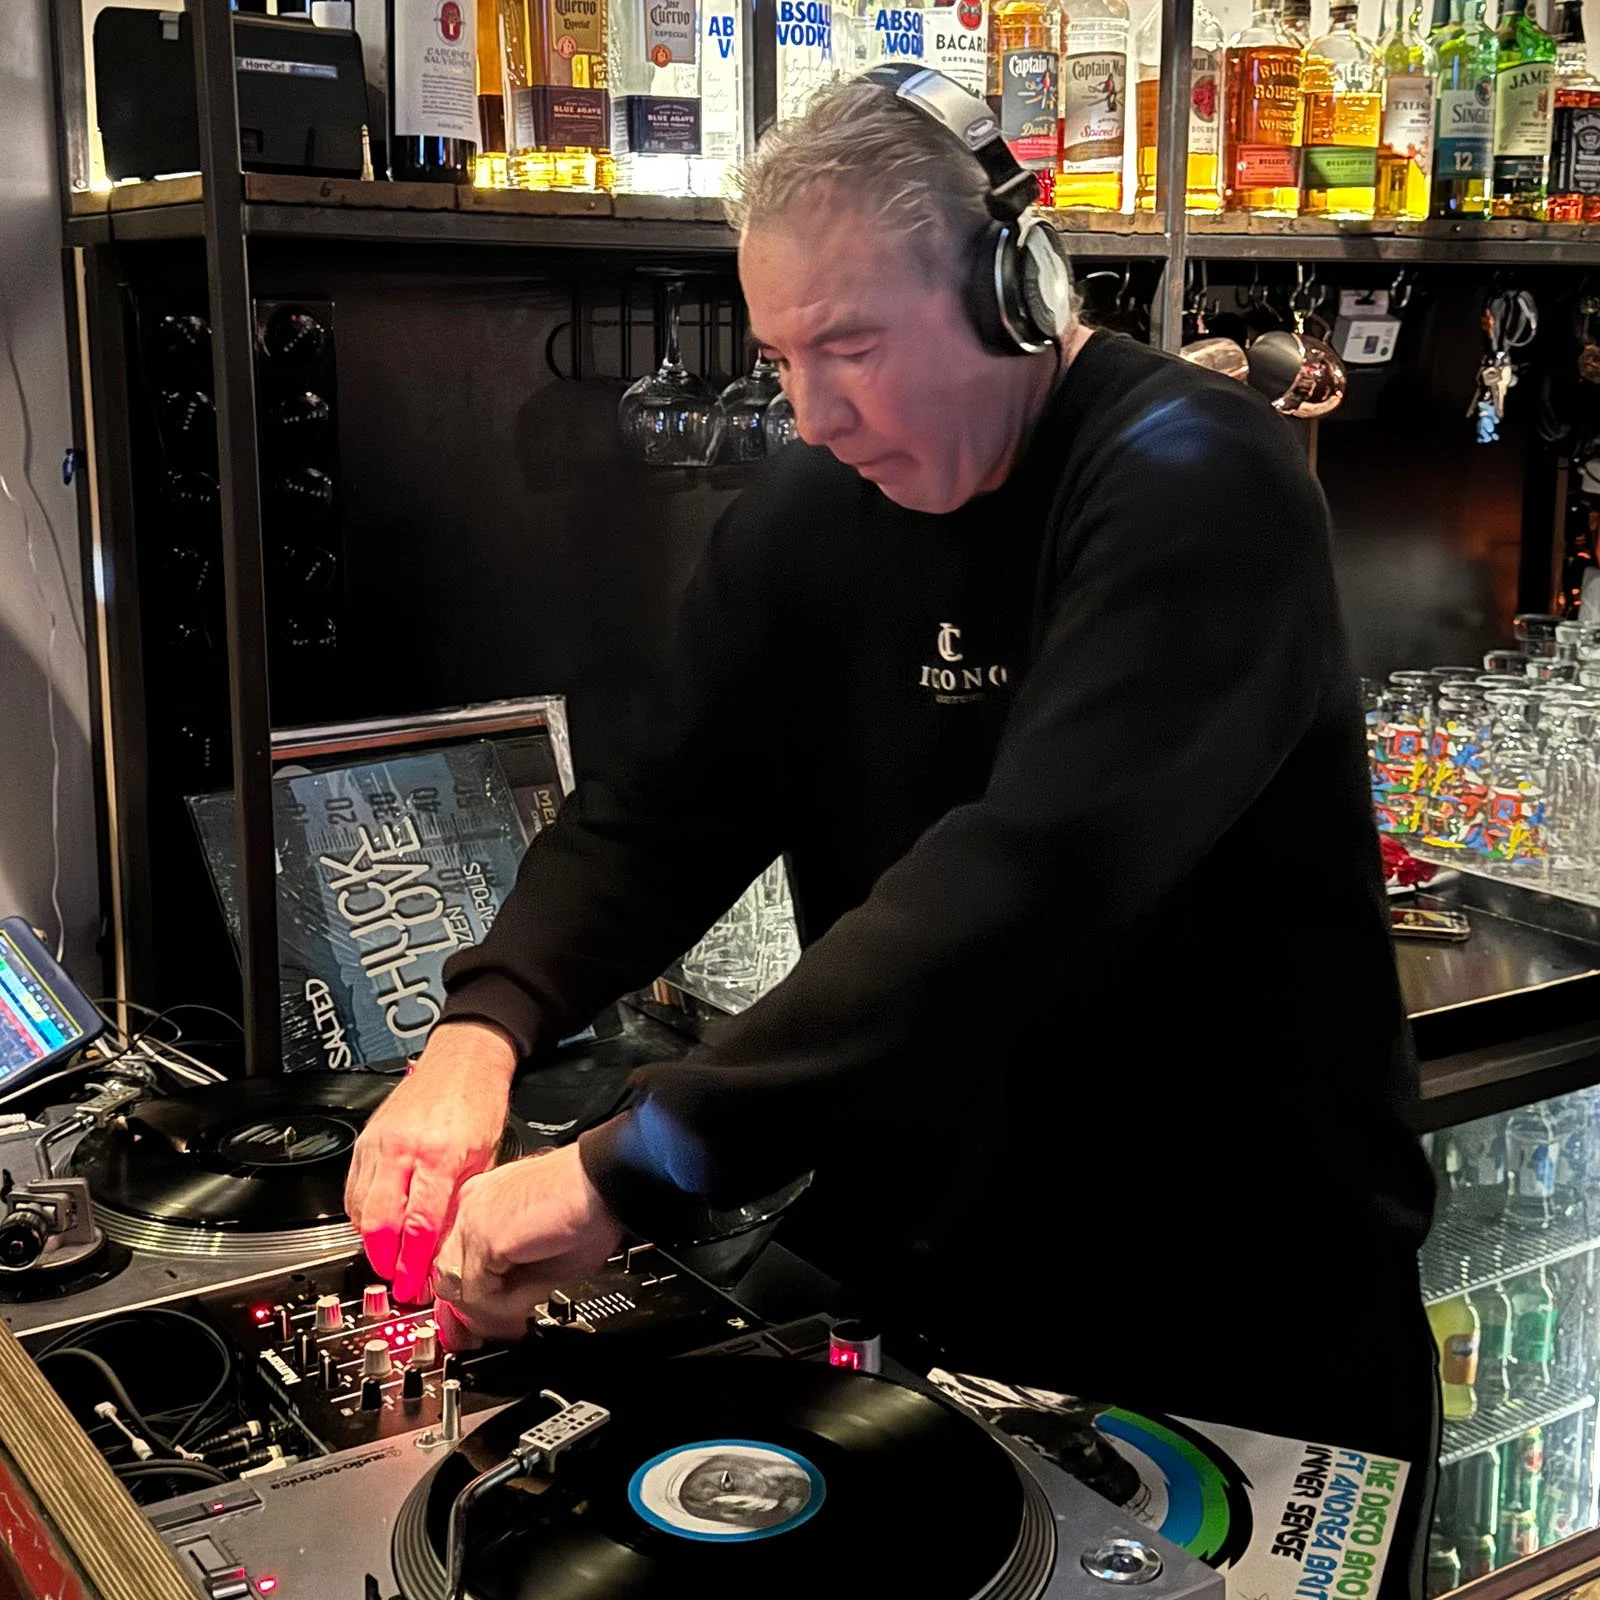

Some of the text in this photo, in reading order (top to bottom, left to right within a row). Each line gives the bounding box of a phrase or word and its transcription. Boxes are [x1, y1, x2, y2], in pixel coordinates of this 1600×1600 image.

[555, 0, 597, 16] Cuervo
[650, 4, 690, 26] Cuervo
[563, 18, 591, 30] Especial
[708, 16, 735, 37] AB
[875, 9, 924, 34] ABSO
[654, 30, 689, 39] ESPECIAL
[885, 32, 924, 58] VOD
[717, 38, 735, 58] V
[1009, 55, 1046, 78] Captain
[1072, 60, 1111, 80] Captain
[1259, 63, 1300, 79] BULLE
[1509, 70, 1551, 90] JAME
[554, 105, 575, 113] BLUE
[648, 114, 695, 124] BLUE AGAVE
[1454, 151, 1473, 171] 12
[325, 797, 358, 825] 20
[358, 815, 459, 956] LOVE
[320, 845, 442, 1038] CHUCK
[305, 977, 353, 1070] SALTED
[269, 1453, 389, 1490] audio-technica
[1335, 1450, 1368, 1476] FT
[1365, 1460, 1401, 1493] THE
[1270, 1444, 1333, 1563] INNER SENSE
[1311, 1473, 1360, 1552] ANDREA
[1350, 1491, 1392, 1547] DISCO
